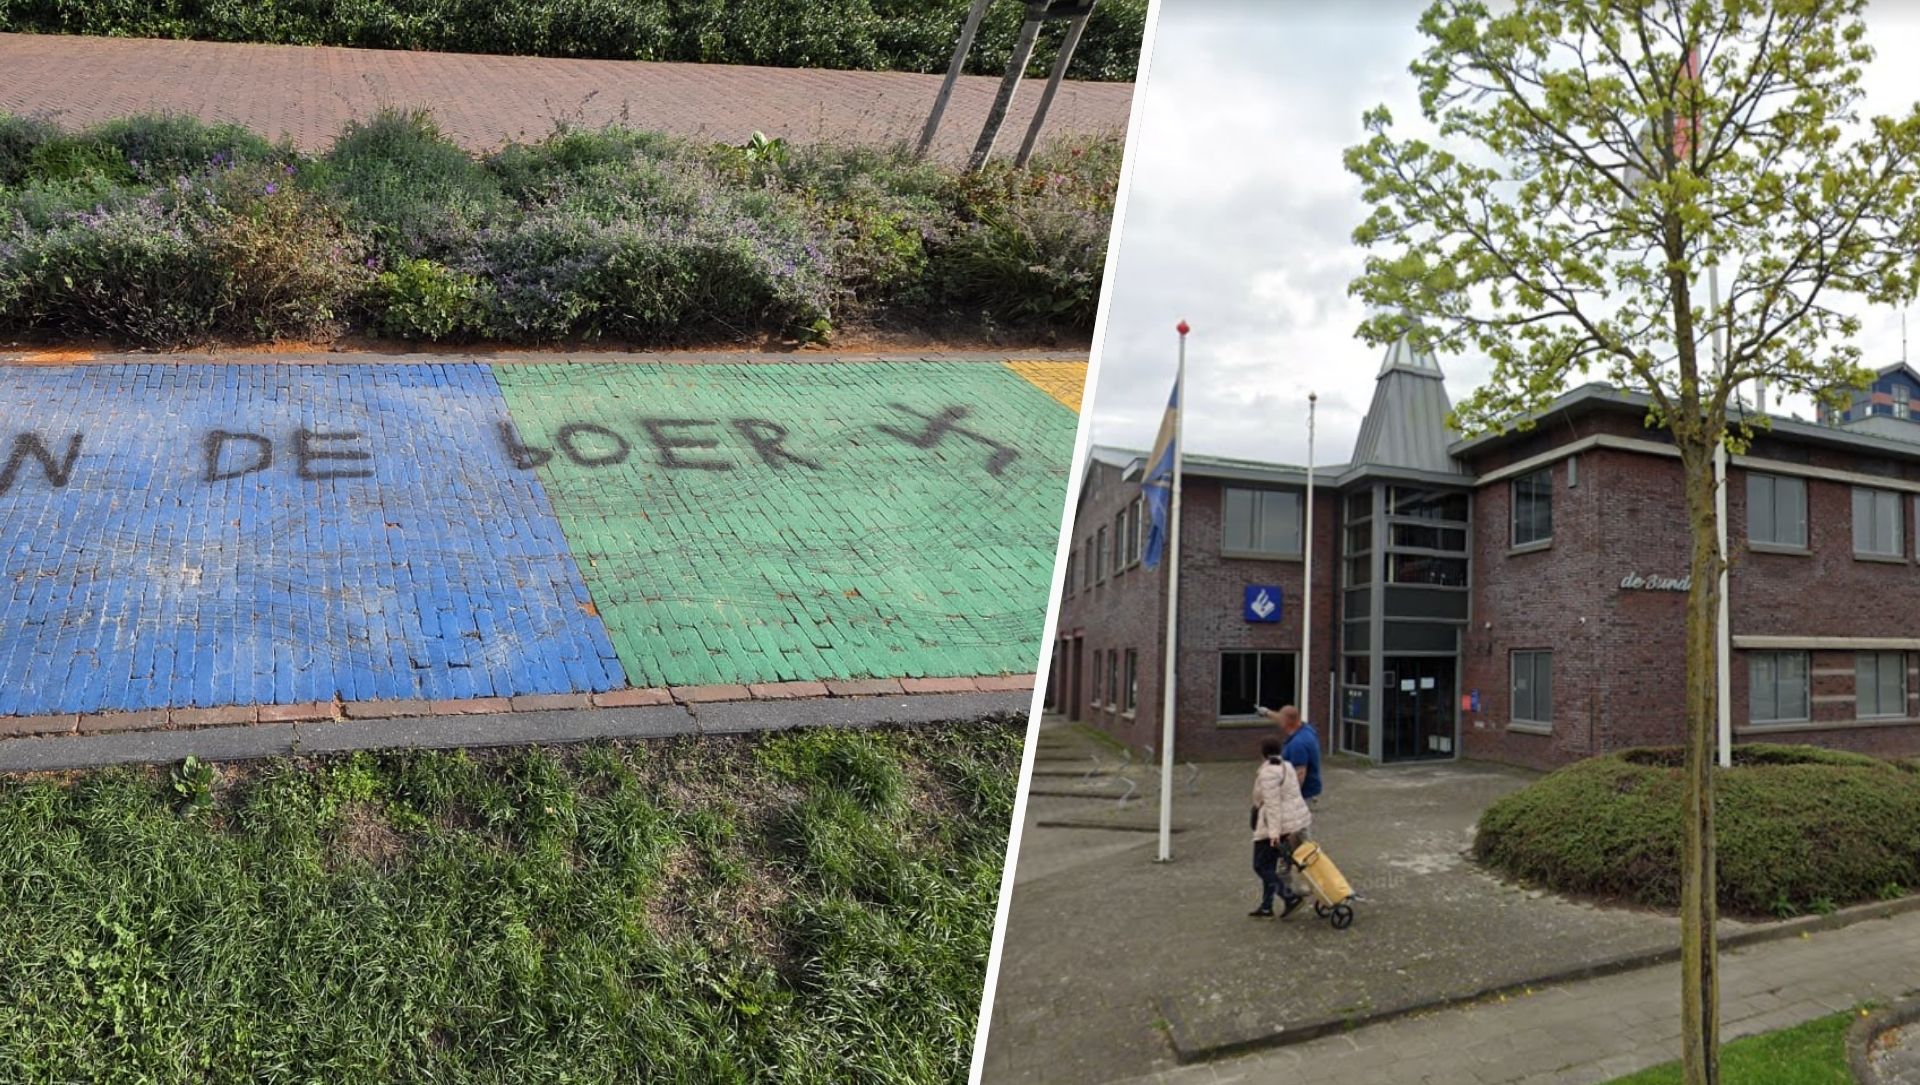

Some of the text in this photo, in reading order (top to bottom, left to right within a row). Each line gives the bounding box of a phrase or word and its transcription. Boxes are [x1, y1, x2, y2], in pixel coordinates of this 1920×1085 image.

[201, 428, 375, 482] DE
[1620, 571, 1692, 591] de Bund
